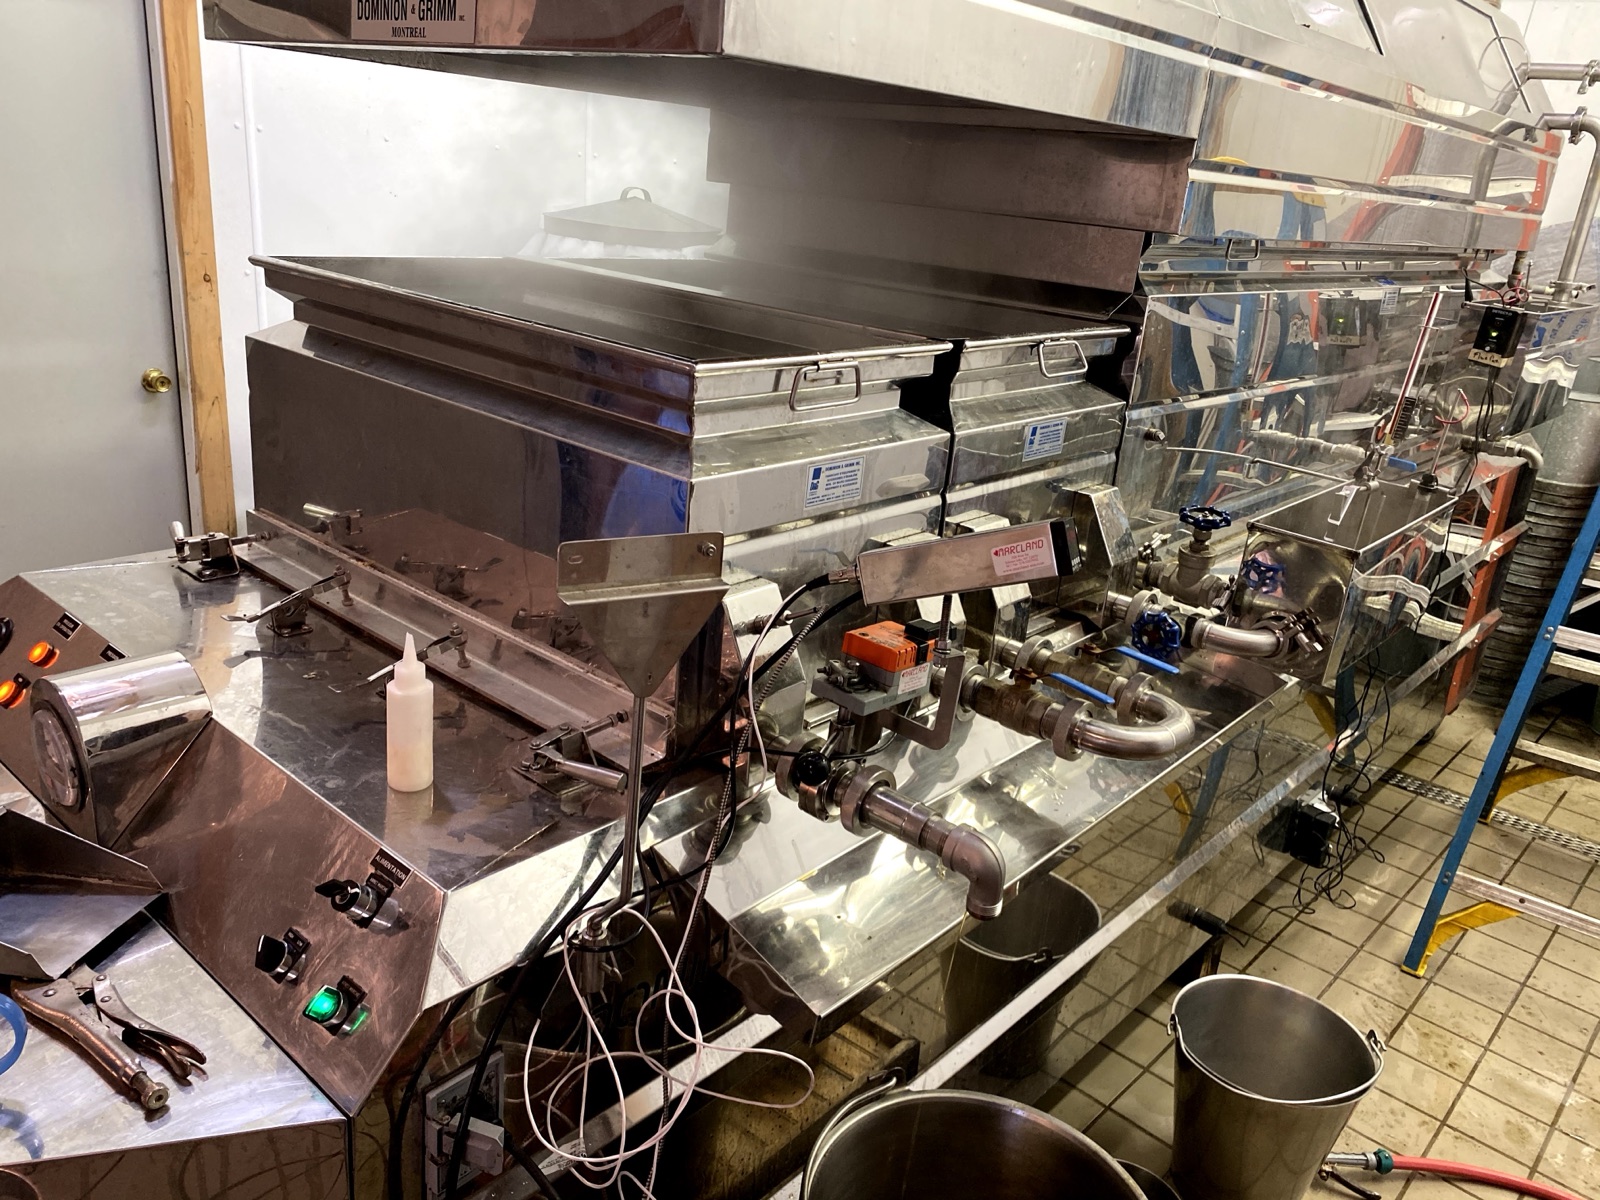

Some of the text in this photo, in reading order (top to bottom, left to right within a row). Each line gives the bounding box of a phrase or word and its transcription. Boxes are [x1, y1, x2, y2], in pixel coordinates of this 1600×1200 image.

[357, 0, 408, 21] DOMINION
[410, 4, 416, 14] &
[418, 0, 457, 21] GRIMM
[391, 27, 427, 38] MONTREAL
[997, 539, 1044, 557] MARCLAND
[374, 854, 407, 881] ALIMENTATION
